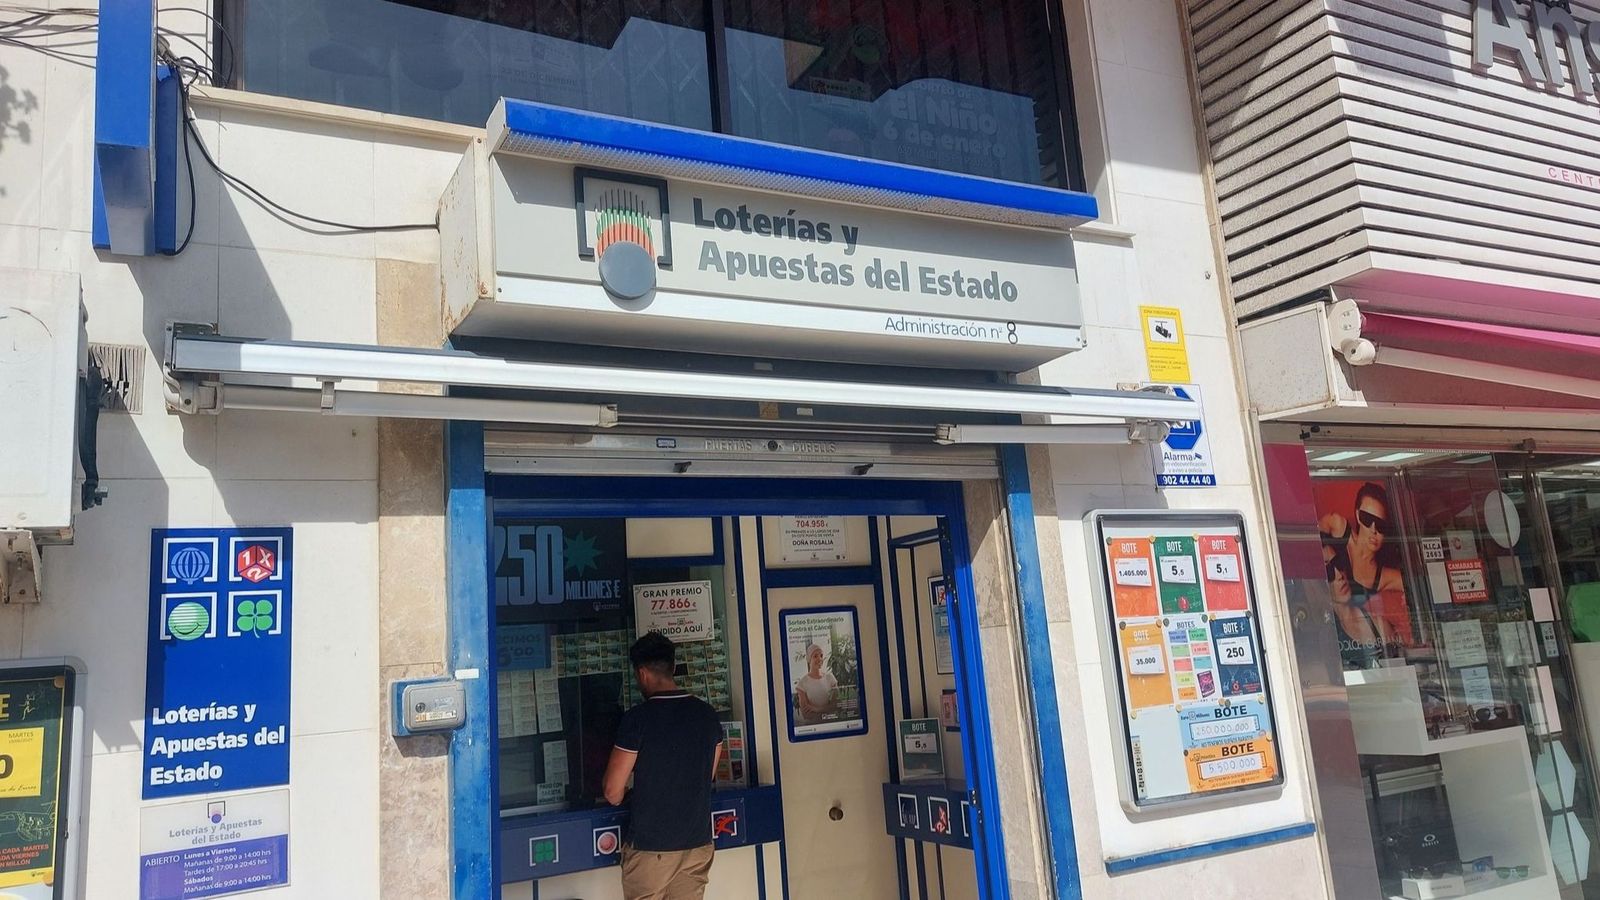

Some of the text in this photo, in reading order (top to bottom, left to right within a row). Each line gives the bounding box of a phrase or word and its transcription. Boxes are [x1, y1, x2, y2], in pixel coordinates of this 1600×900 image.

[1472, 0, 1600, 98] An
[926, 95, 999, 136] Niño
[1549, 167, 1600, 187] CENT
[693, 197, 859, 255] Loterías y
[698, 240, 1019, 303] Apuestas del Estado
[884, 316, 987, 339] Administración
[1006, 321, 1019, 345] 8
[705, 438, 752, 451] PUERTAS
[1163, 451, 1193, 461] Alarma
[1162, 475, 1211, 485] 902 44 44 40
[796, 520, 825, 528] 704.958
[1121, 542, 1138, 554] BOTE
[1166, 541, 1183, 552] BOTE
[1211, 539, 1227, 551] BOTE
[495, 525, 565, 606] 250
[566, 580, 612, 601] MILLONES
[642, 587, 702, 598] GRAN PREMIO
[651, 598, 691, 611] 77.866
[1176, 621, 1196, 630] BOTES
[1222, 622, 1239, 633] BOTE
[1133, 630, 1150, 642] BOTE
[1226, 647, 1245, 659] 250
[1135, 656, 1156, 665] 35.000
[152, 702, 257, 725] Loterías y
[1213, 704, 1248, 719] BOTE
[911, 722, 927, 732] BOTE
[150, 725, 286, 759] Apuestas del
[1221, 742, 1254, 757] BOTE
[150, 761, 223, 786] Estado
[169, 818, 263, 839] Loterías y Apuestas
[191, 831, 241, 846] del Estado
[23, 844, 49, 852] MARTES
[183, 851, 205, 860] Lunes
[211, 846, 237, 855] Viernes
[12, 851, 40, 859] VIERNES
[145, 855, 180, 867] ABIERTO
[183, 857, 213, 868] Mañanas
[214, 855, 223, 864] de
[223, 854, 237, 862] 9:00
[244, 851, 261, 859] 14:00
[262, 849, 272, 857] hrs
[183, 867, 205, 877] Tardes
[206, 865, 215, 873] de
[216, 862, 234, 872] 17:00
[240, 859, 257, 868] 20:45
[257, 858, 268, 866] hrs
[183, 875, 214, 886] Sábados
[183, 883, 213, 894] Mañanas
[214, 881, 223, 889] de
[223, 878, 237, 888] 9:00
[244, 875, 261, 884] 14:00
[262, 873, 272, 882] hrs
